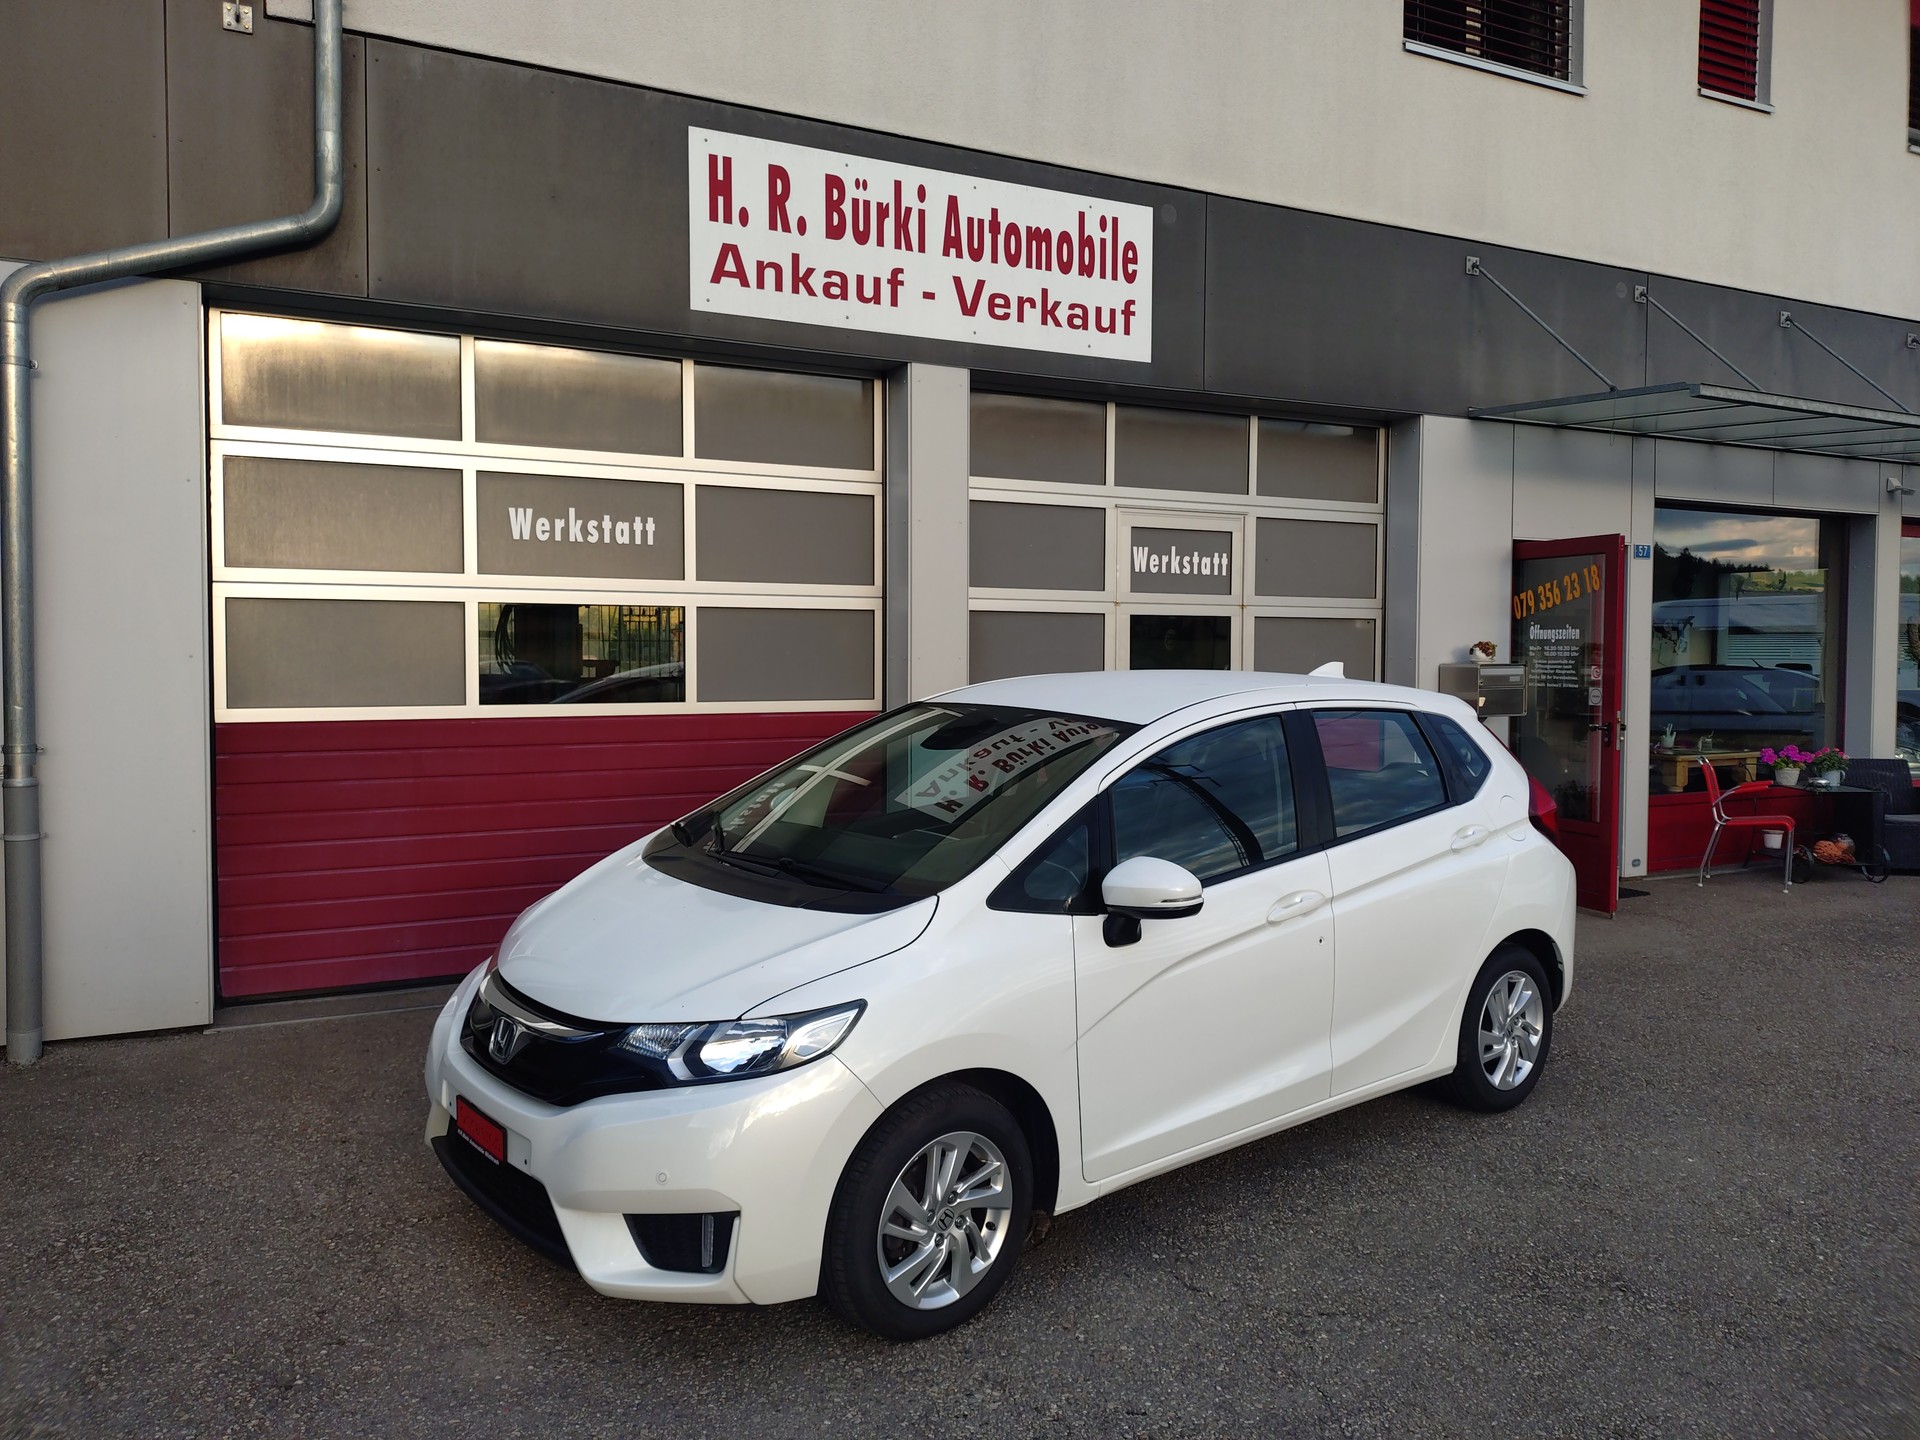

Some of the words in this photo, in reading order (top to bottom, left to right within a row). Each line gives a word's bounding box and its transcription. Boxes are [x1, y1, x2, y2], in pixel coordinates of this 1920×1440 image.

[708, 153, 749, 227] H.
[768, 163, 807, 236] R.
[825, 173, 927, 254] Bürki
[942, 195, 1139, 284] Automobile
[709, 242, 904, 308] Ankauf
[922, 290, 936, 301] -
[952, 275, 1136, 336] Verkauf
[508, 507, 656, 545] Werkstatt
[1132, 546, 1228, 576] Werkstatt
[1638, 545, 1648, 557] 57
[1513, 589, 1535, 620] 079
[1537, 578, 1561, 611] 356
[1563, 572, 1580, 602] 23
[1583, 564, 1600, 593] 18
[1529, 621, 1580, 643] Öffnungszeiten
